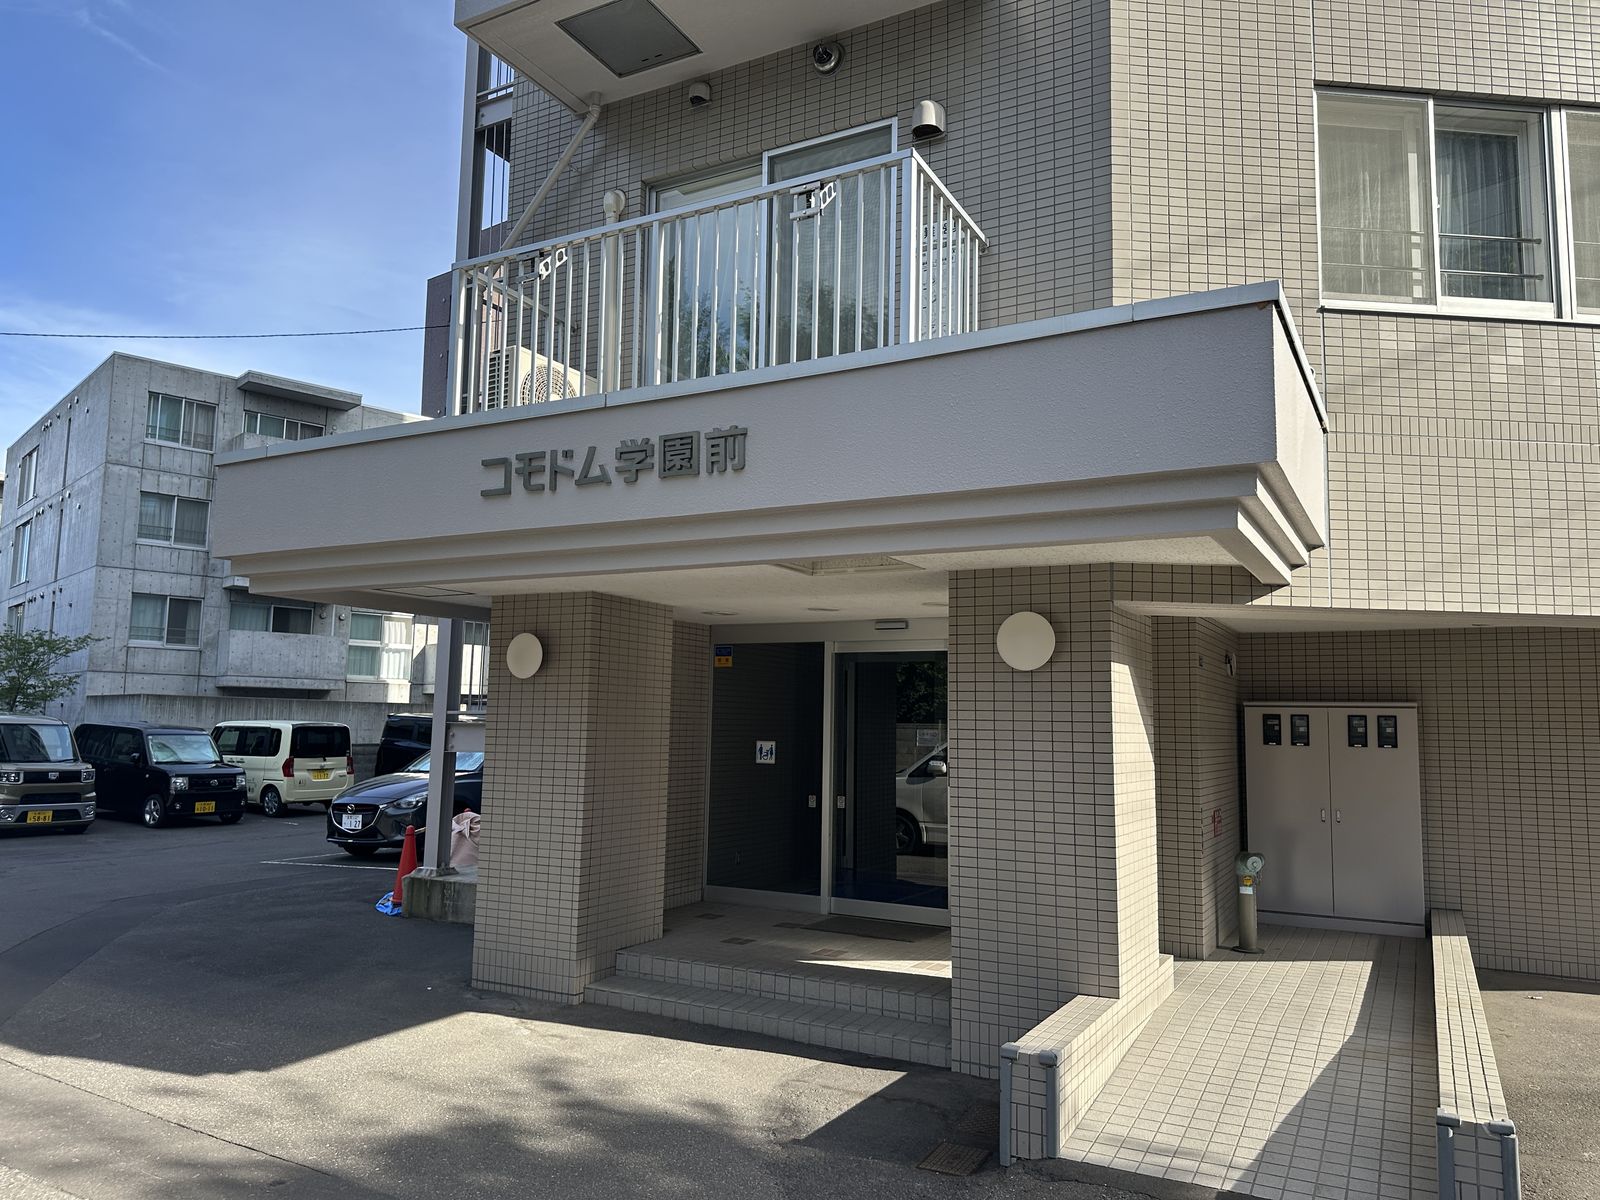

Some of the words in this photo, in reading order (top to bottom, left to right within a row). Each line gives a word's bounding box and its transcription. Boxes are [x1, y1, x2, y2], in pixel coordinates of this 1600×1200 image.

[481, 425, 748, 497] コモドム学園前
